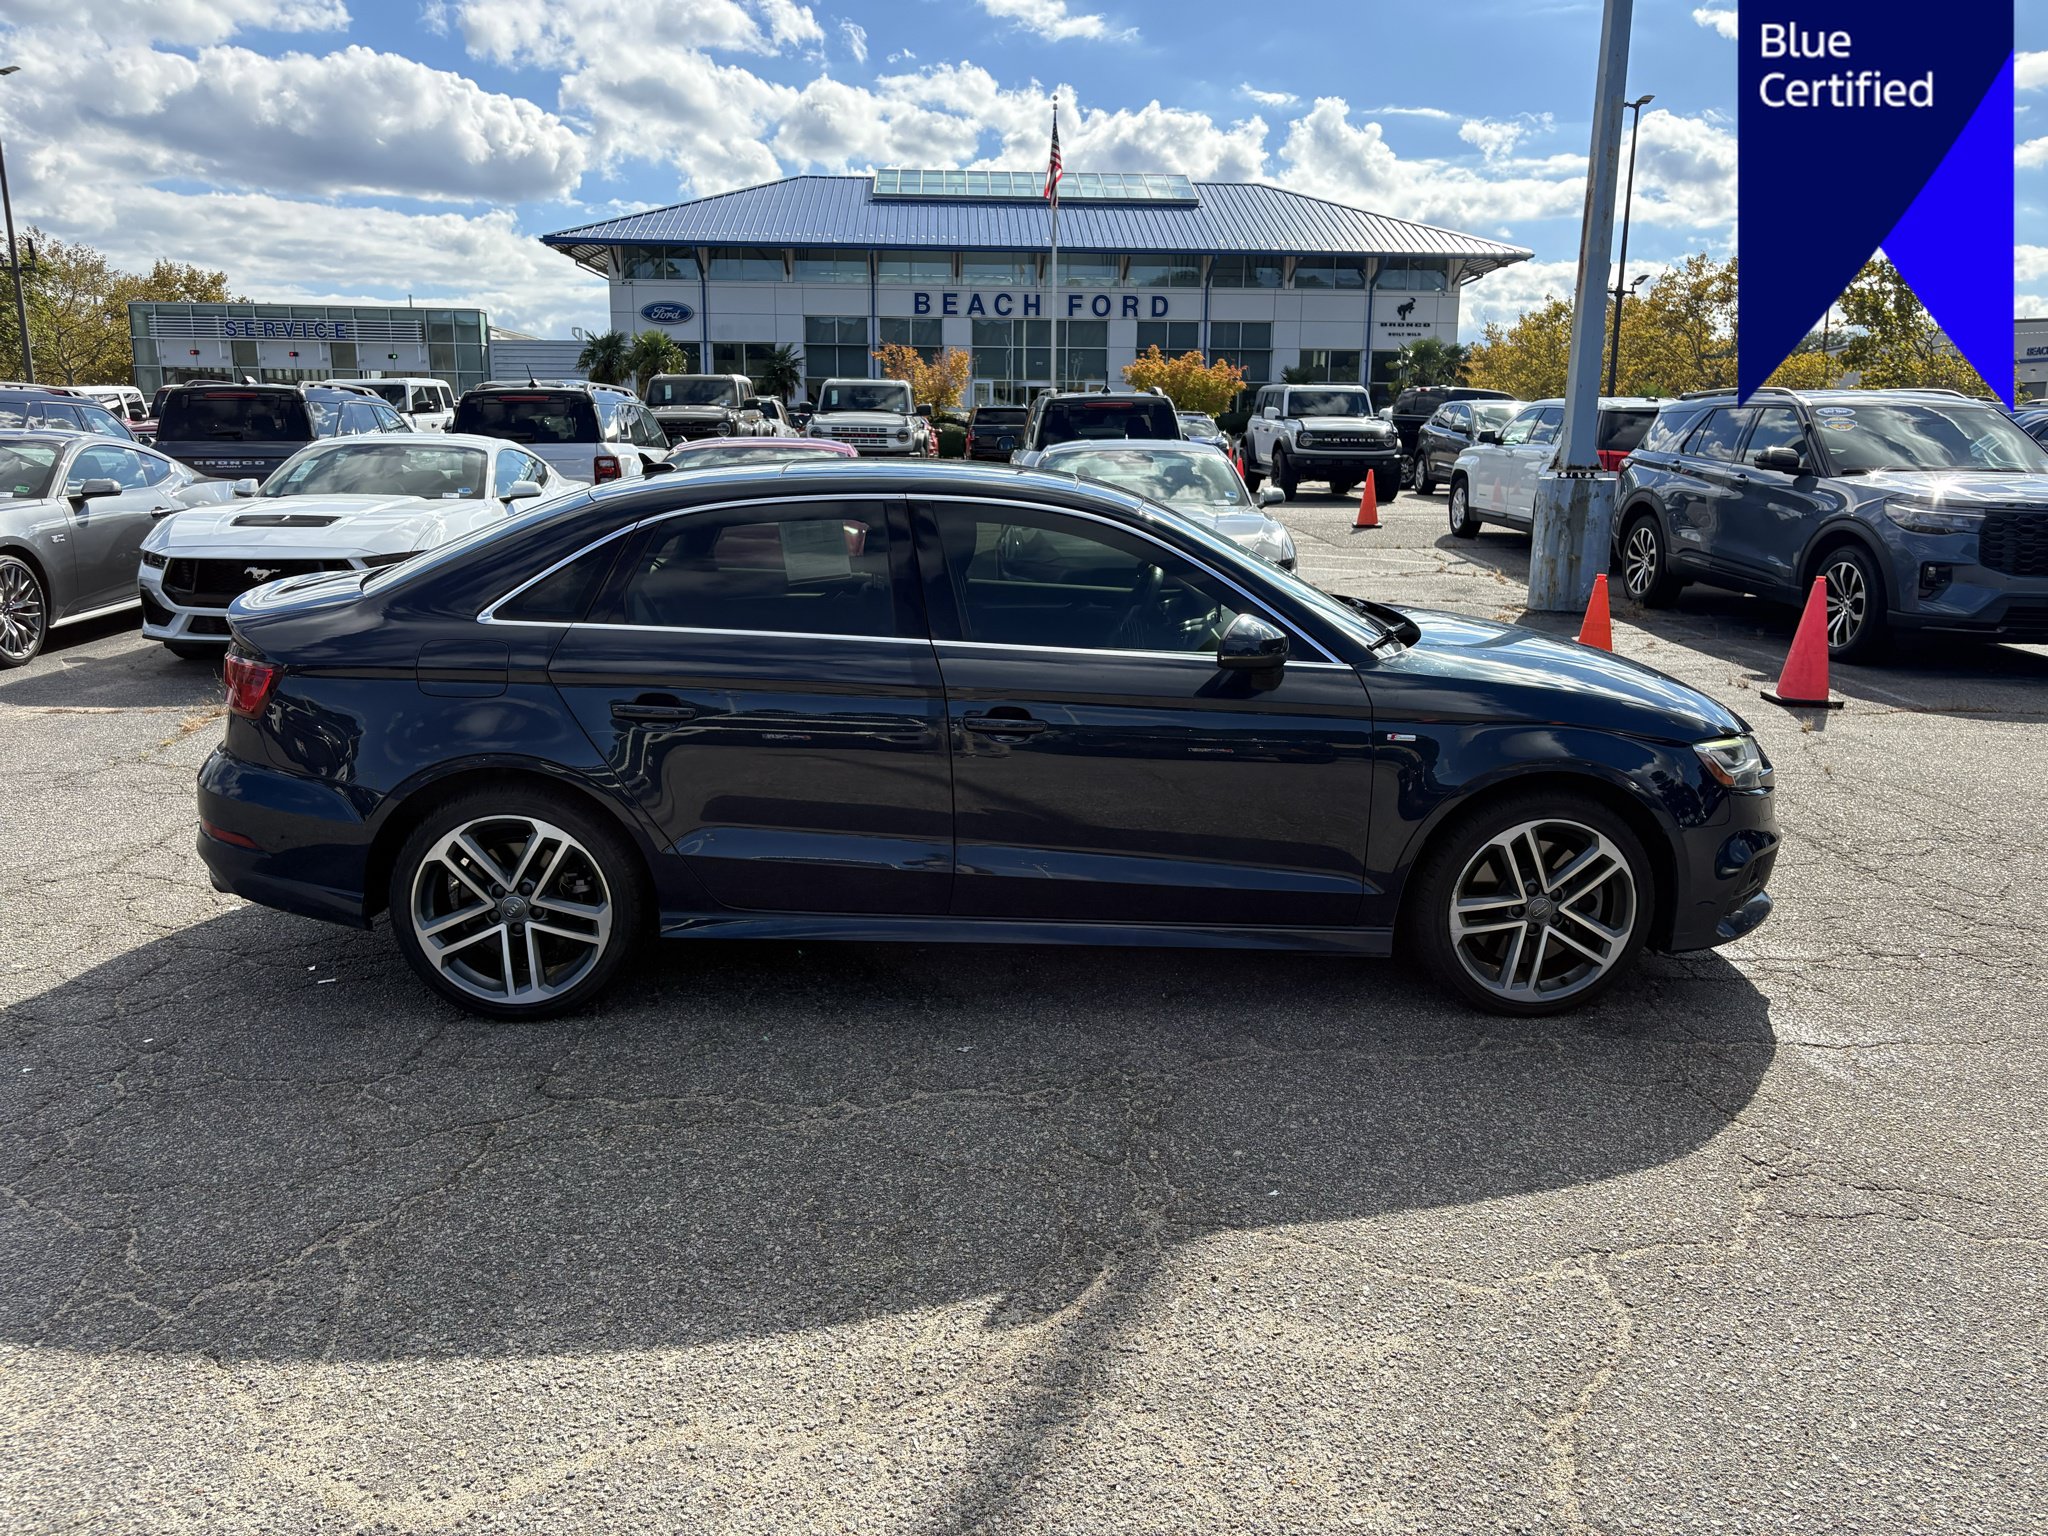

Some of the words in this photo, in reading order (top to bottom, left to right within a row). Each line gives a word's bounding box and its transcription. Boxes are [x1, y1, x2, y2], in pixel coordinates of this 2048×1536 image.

[651, 306, 681, 319] Ford
[914, 292, 1041, 316] BEACH
[1068, 295, 1169, 317] FORD
[225, 320, 347, 339] SERVICE
